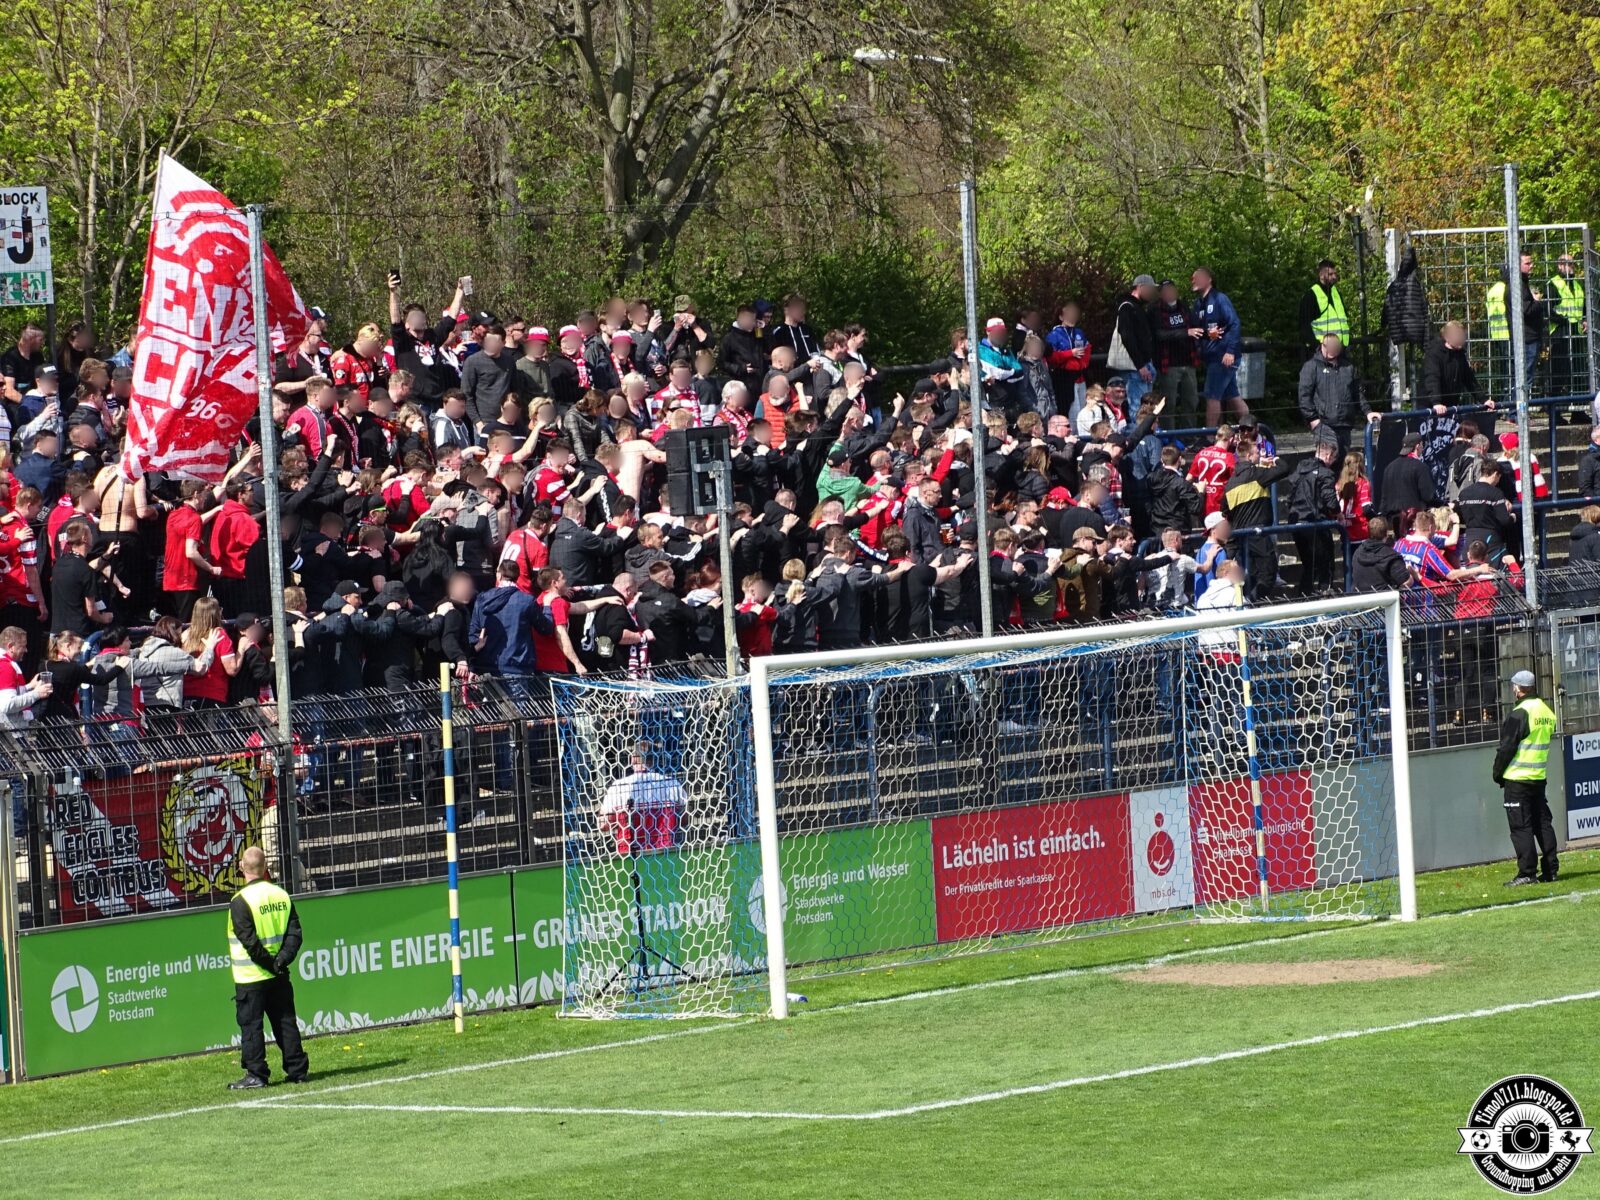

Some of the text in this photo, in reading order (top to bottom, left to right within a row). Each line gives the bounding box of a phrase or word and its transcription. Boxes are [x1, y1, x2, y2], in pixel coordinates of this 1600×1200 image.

[7, 216, 34, 264] J
[187, 398, 238, 429] 966
[1198, 457, 1226, 486] 22
[1565, 634, 1577, 667] 4
[1575, 780, 1600, 797] DEIN
[55, 793, 93, 829] RED
[62, 825, 139, 869] EAGLES
[943, 825, 1106, 869] Lächeln ist einfach.
[72, 859, 167, 905] COTTBUS
[793, 862, 909, 890] Energie und Wasser
[945, 885, 958, 896] Der
[959, 879, 1003, 894] Privatkredit
[1004, 877, 1016, 888] der
[794, 893, 844, 909] Stadtwerke
[796, 911, 833, 925] Potsdam
[299, 939, 383, 981] GRÜNE
[391, 927, 494, 969] ENERGIE
[533, 908, 622, 948] GRÜNES
[630, 896, 725, 935] STADION
[106, 953, 231, 983] Energie und Wass
[108, 986, 167, 1005] Stadtwerke
[109, 1006, 154, 1022] Potsdam
